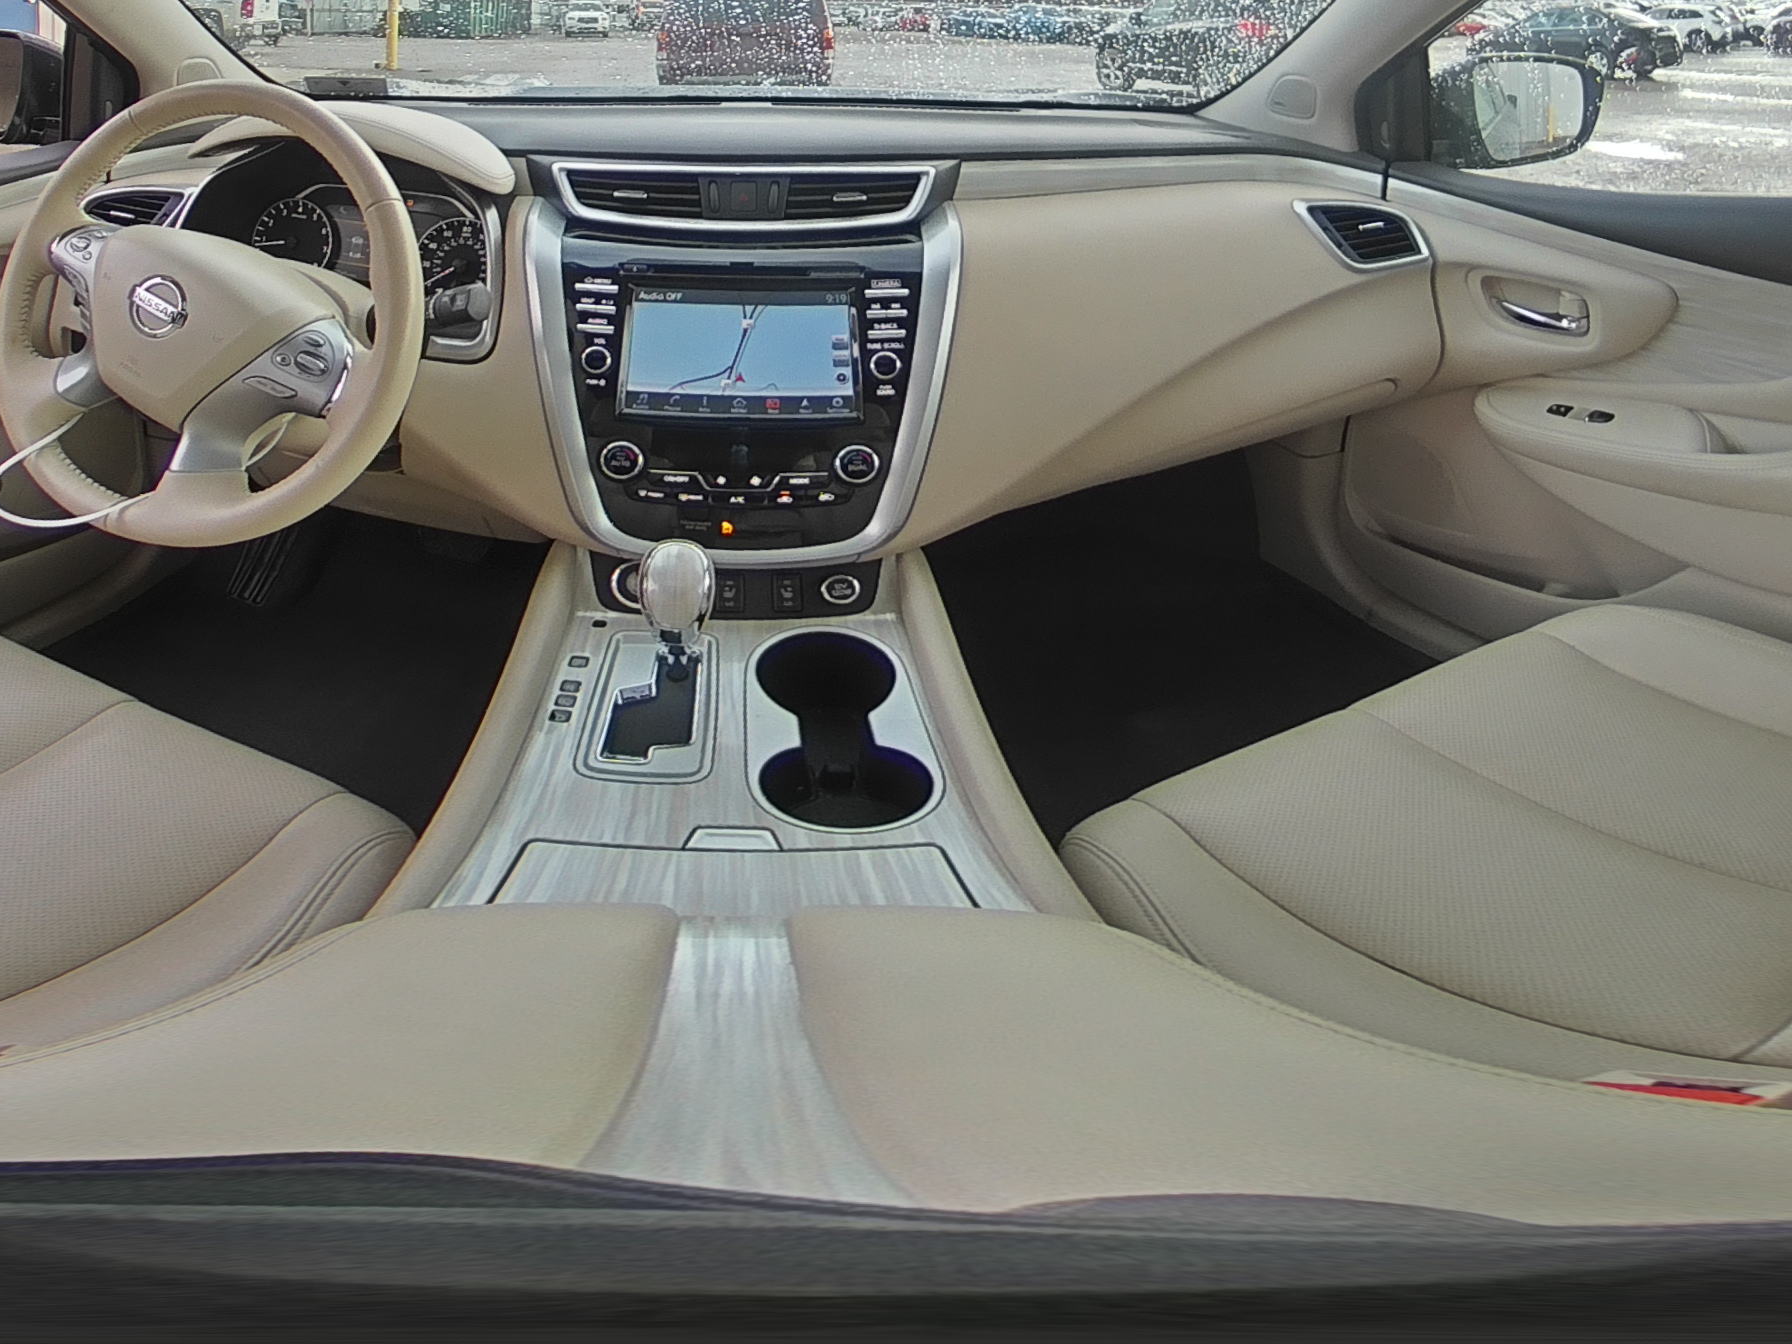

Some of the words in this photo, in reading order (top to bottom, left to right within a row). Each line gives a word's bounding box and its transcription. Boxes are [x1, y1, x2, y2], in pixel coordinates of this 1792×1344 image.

[638, 291, 664, 300] Audio
[825, 293, 847, 303] 9:19
[135, 291, 185, 324] NISSAN
